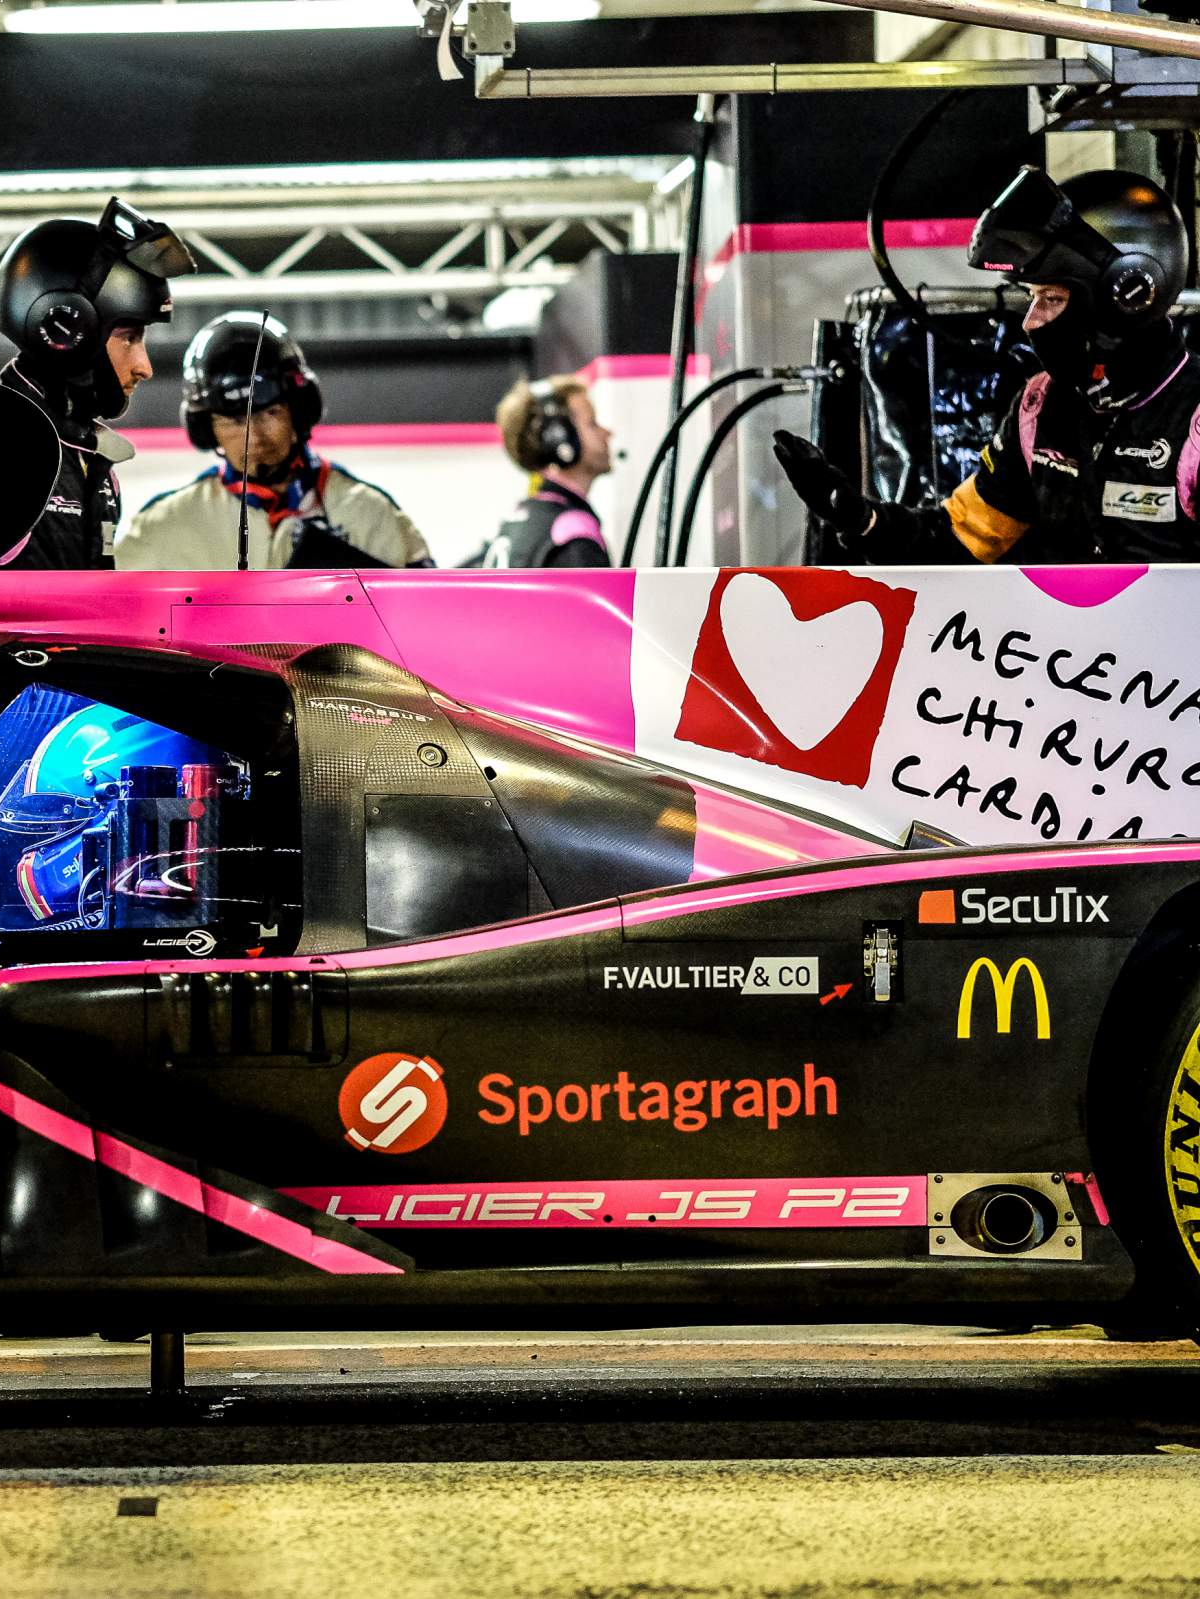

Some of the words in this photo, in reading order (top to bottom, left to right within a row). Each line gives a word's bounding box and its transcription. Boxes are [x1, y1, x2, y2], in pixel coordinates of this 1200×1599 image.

[143, 938, 203, 946] LIGIER
[604, 965, 744, 989] F.VAULTIER
[752, 967, 771, 987] &
[778, 966, 812, 987] CO
[478, 1063, 838, 1135] Sportagraph
[325, 1191, 604, 1222] LIGIER
[626, 1189, 758, 1220] JS
[778, 1187, 910, 1219] P2
